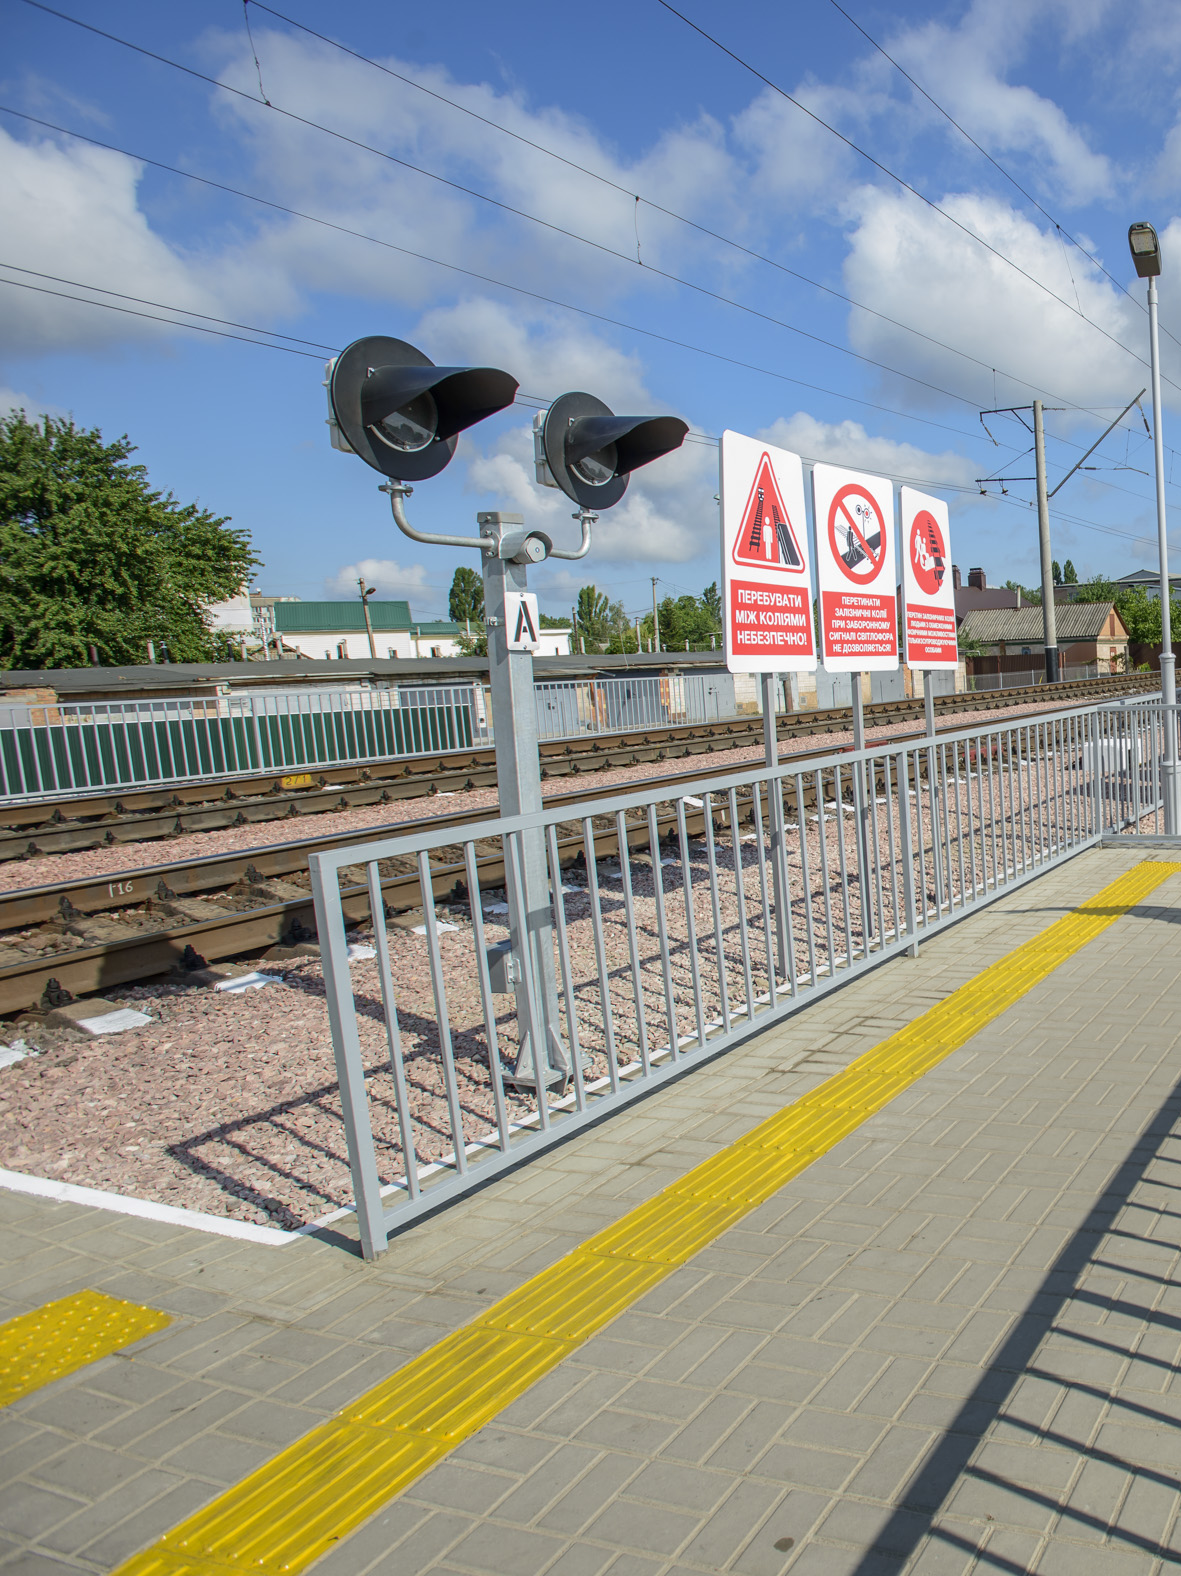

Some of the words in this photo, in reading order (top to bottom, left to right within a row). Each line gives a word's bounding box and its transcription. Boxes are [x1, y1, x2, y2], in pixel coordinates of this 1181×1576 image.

[738, 589, 802, 608] ПЕРЕБУВАТИ
[841, 596, 880, 607] ПЕРЕТИНАТИ
[735, 609, 758, 625] МІЖ
[759, 611, 806, 627] КОЛІЯМИ
[834, 608, 871, 618] ЗАЛІЗНИЧНІ
[831, 620, 845, 629] ПРИ
[846, 620, 890, 630] ЗАБОРОННОМУ
[737, 630, 807, 646] НЕБЕЗПЕЧНО!
[829, 631, 856, 641] СИГНАЛІ
[856, 632, 893, 641] СВІТЛОФОРА
[833, 644, 842, 653] НЕ
[842, 643, 892, 654] ДОЗВОЛЯЄТЬСЯ!
